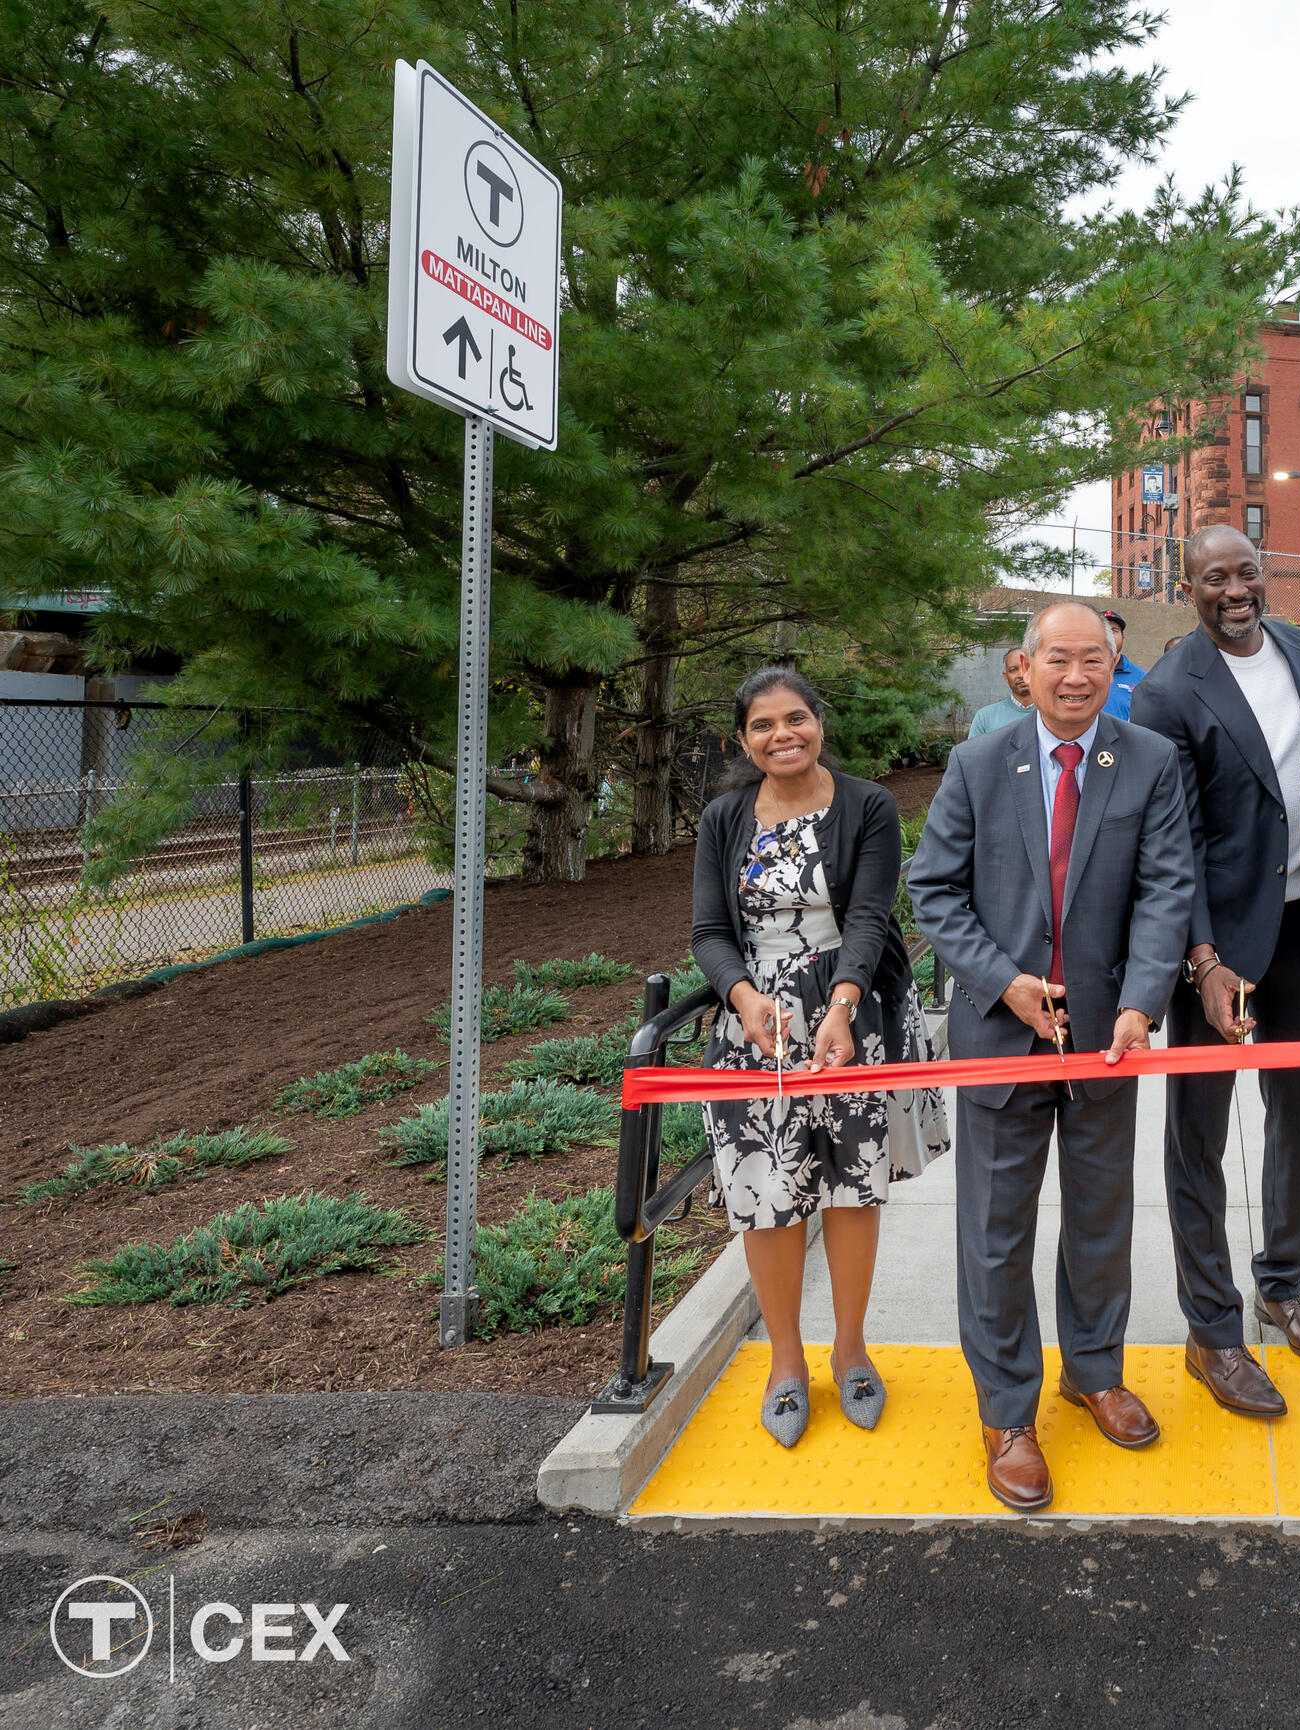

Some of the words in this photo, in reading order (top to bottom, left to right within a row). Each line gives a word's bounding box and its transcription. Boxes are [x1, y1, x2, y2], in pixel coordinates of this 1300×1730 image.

[477, 159, 514, 228] T
[429, 254, 512, 325] MATTAPAN
[516, 312, 547, 347] LINE
[457, 235, 526, 303] MILTON
